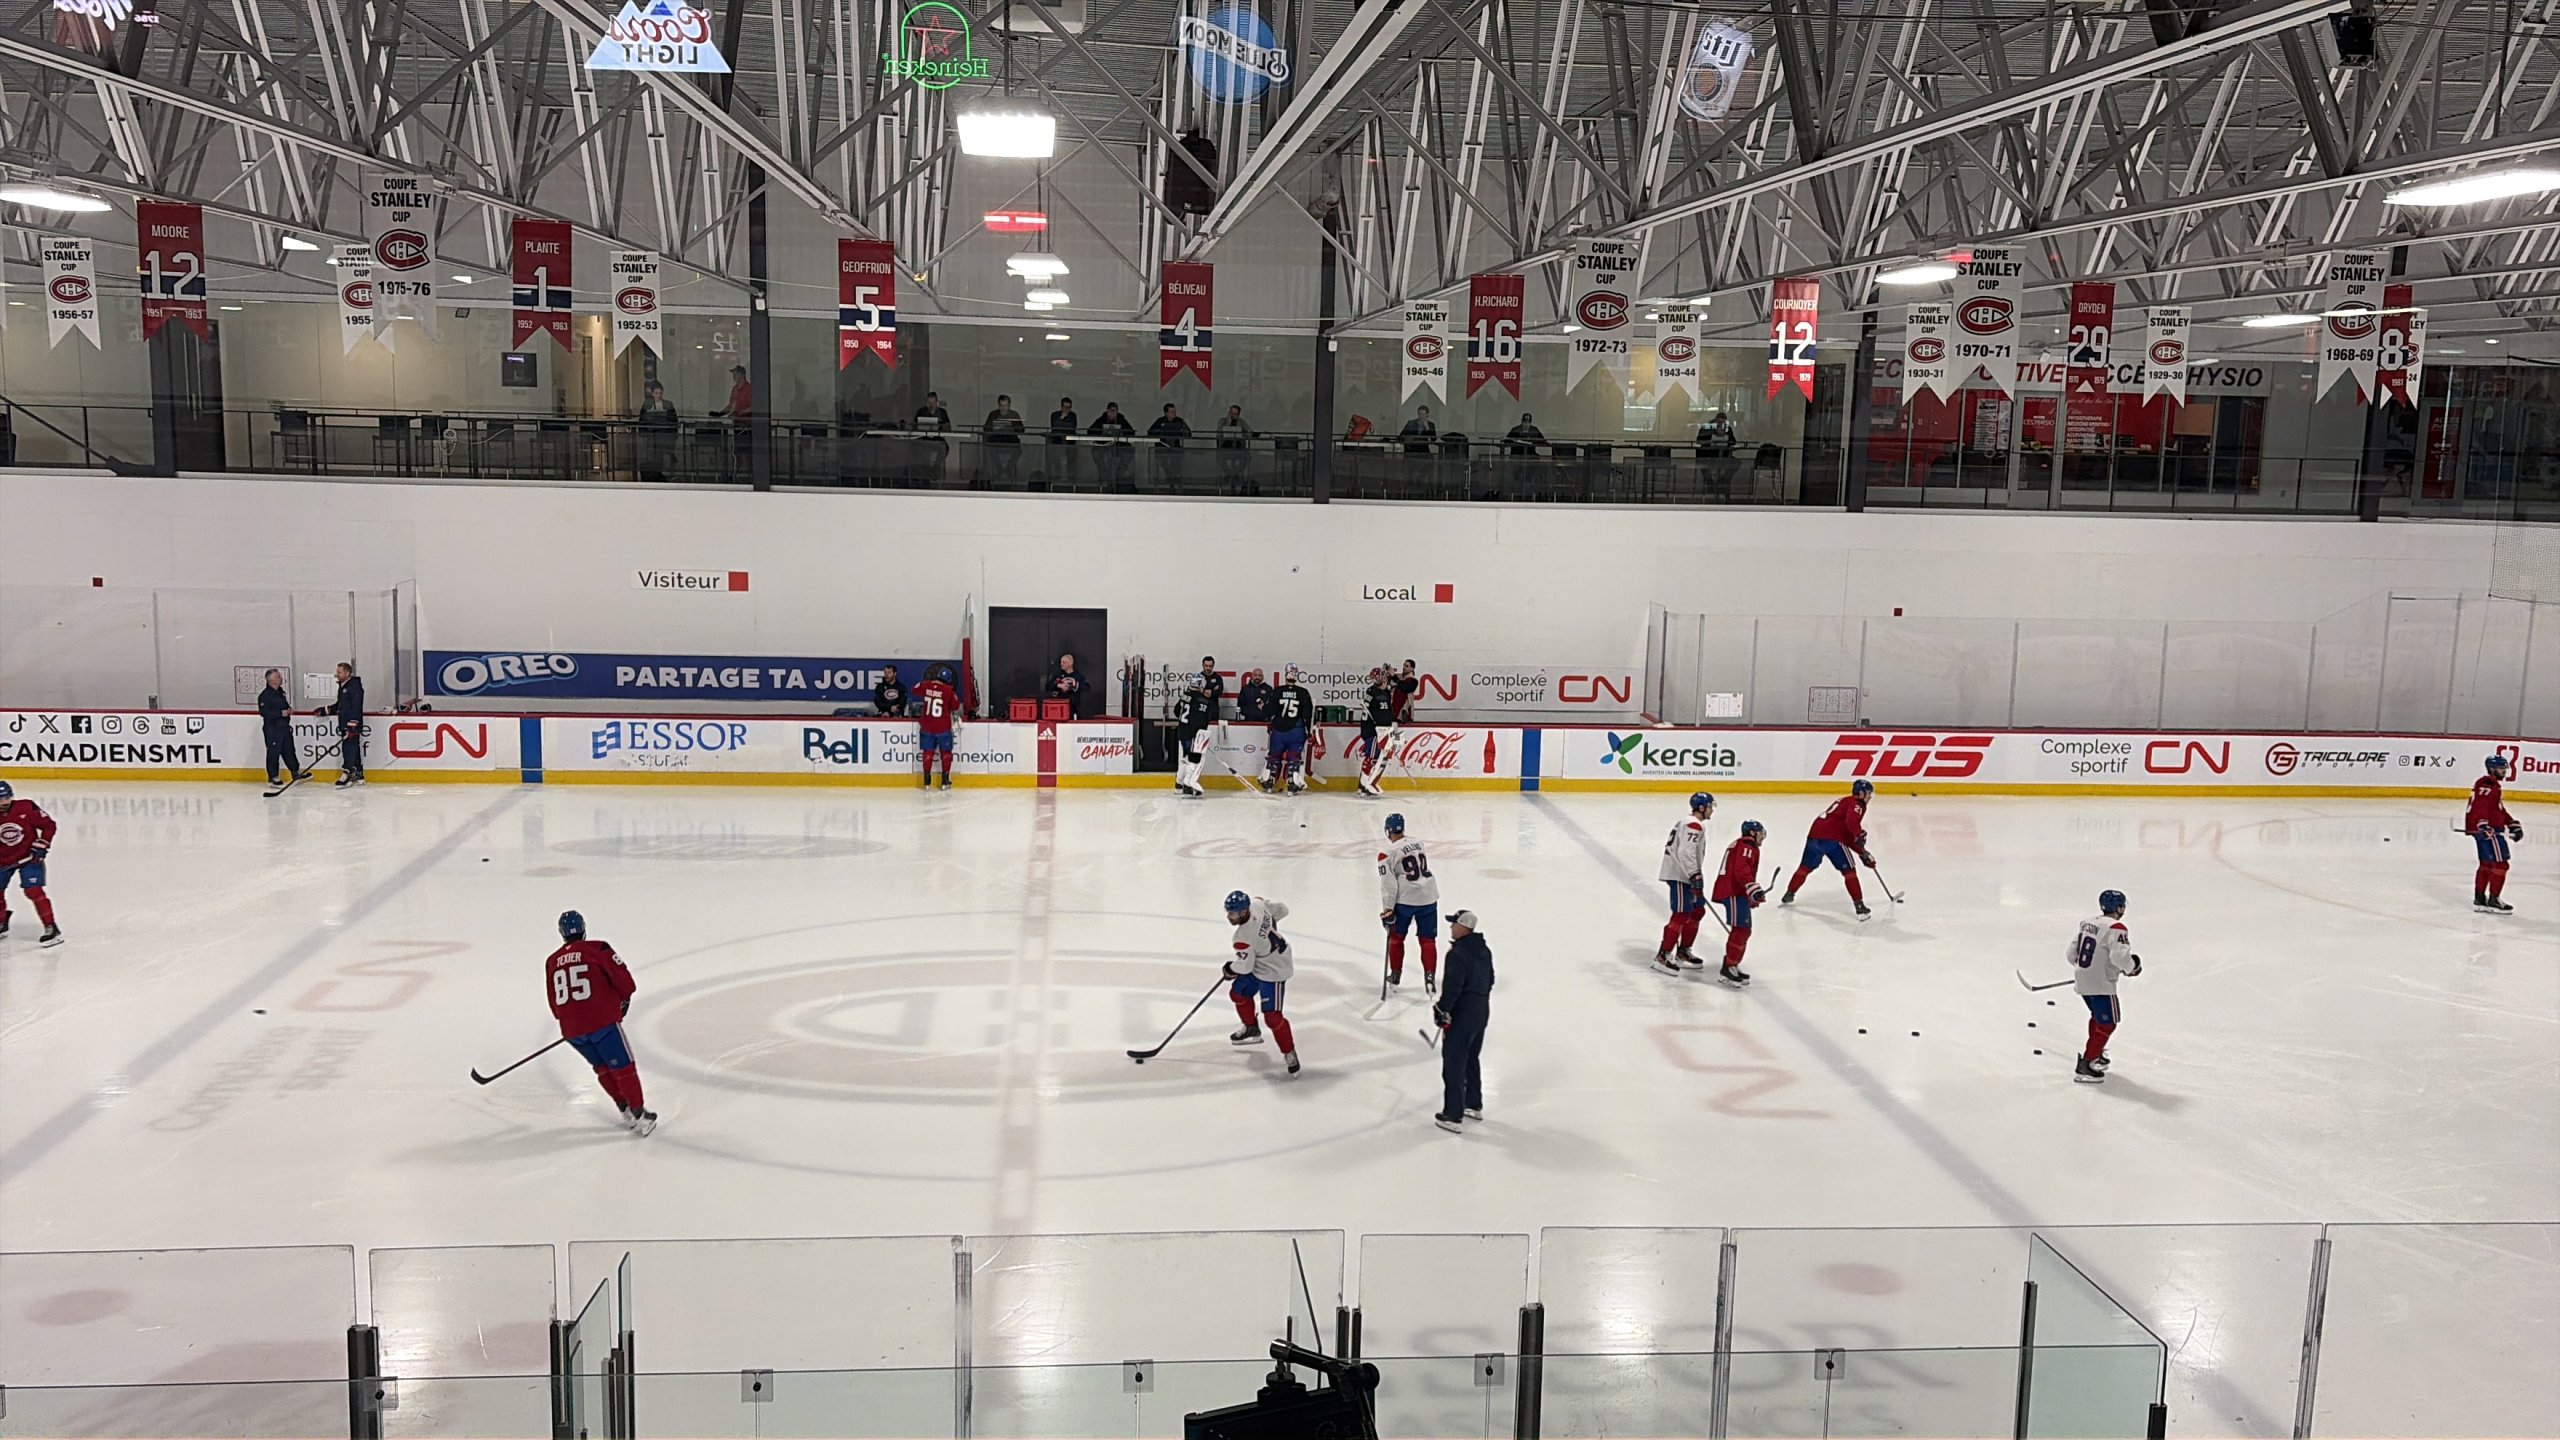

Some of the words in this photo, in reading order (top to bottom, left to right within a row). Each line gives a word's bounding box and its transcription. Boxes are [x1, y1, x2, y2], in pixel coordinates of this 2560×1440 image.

[384, 179, 418, 190] COUPE
[371, 192, 432, 208] STANLEY
[392, 211, 411, 222] CUP
[152, 225, 190, 239] MOORE
[53, 241, 80, 249] COUPE
[525, 241, 560, 254] PLANTE
[1592, 242, 1624, 254] COUPE
[44, 251, 91, 261] STANLEY
[622, 254, 647, 262] COUPE
[1973, 250, 2009, 260] COUPE
[2344, 254, 2374, 266] COUPE
[61, 263, 77, 271] CUP
[613, 263, 658, 274] STANLEY
[842, 261, 891, 274] GEOFFRION
[1577, 255, 1637, 271] STANLEY
[1957, 262, 2022, 276] STANLEY
[145, 251, 201, 301] 12
[354, 269, 370, 277] CUP
[627, 275, 643, 283] CUP
[1596, 273, 1616, 284] CUP
[2330, 267, 2385, 281] STANLEY
[378, 281, 431, 296] 1975-76
[533, 266, 553, 312] 1
[1168, 281, 1206, 295] BÉLIVEAU
[1977, 280, 1999, 290] CUP
[2347, 284, 2366, 295] CUP
[1474, 296, 1519, 307] H.RICHARD
[1773, 299, 1817, 310] COURNOYER
[855, 286, 879, 331] 5
[1918, 306, 1941, 314] COUPE
[2078, 302, 2106, 314] DRYDEN
[2159, 309, 2181, 317] COUPE
[52, 310, 94, 319] 1956-57
[345, 316, 374, 325] 1955-
[1405, 312, 1447, 321] STANLEY
[1658, 313, 1700, 323] STANLEY
[1908, 315, 1950, 324] STANLEY
[517, 320, 533, 328] 1952
[552, 321, 568, 331] 1963
[617, 320, 658, 330] 1952-53
[2149, 317, 2189, 327] STANLEY
[1175, 307, 1198, 352] 4
[2161, 328, 2175, 336] CUP
[843, 340, 859, 348] 1950
[876, 341, 892, 349] 1964
[1474, 319, 1517, 363] 16
[1575, 339, 1627, 353] 1972-73
[1772, 322, 1813, 365] 12
[2070, 325, 2109, 368] 29
[1955, 344, 2011, 357] 1970-71
[2326, 348, 2374, 361] 1968-69
[2381, 329, 2404, 371] 8
[1406, 367, 1444, 376] 1945-46
[1471, 371, 1485, 379] 1955
[1503, 371, 1517, 380] 1975
[1659, 368, 1696, 376] 1943-44
[1908, 369, 1944, 378] 1930-31
[2149, 371, 2183, 380] 1929-30
[2186, 367, 2263, 387] HYSIO
[638, 571, 721, 589] Visiteur
[1363, 585, 1417, 600] Local
[442, 654, 576, 691] OREO
[616, 666, 760, 689] PARTAGE
[768, 669, 807, 689] TA
[1471, 673, 1547, 688] Complexe
[1323, 687, 1364, 702] sporti
[1558, 676, 1631, 703] CN
[1496, 689, 1545, 704] sportif
[925, 699, 944, 718] 76
[1198, 704, 1207, 712] 32
[1279, 699, 1300, 718] 75
[1379, 702, 1389, 710] 35
[389, 723, 487, 758] CN
[628, 722, 747, 750] ESSOR
[881, 731, 917, 745] Tout
[803, 728, 869, 764] Bell
[2041, 739, 2132, 757] Complexe
[1642, 742, 1736, 767] kersia
[1819, 735, 1994, 777] RDS
[2145, 741, 2231, 774] CN
[2303, 751, 2390, 763] TRICOLORE
[2070, 758, 2129, 776] sportif
[2479, 787, 2491, 796] 77
[1687, 832, 1699, 843] 72
[1743, 847, 1753, 858] 11
[553, 964, 592, 1006] 85
